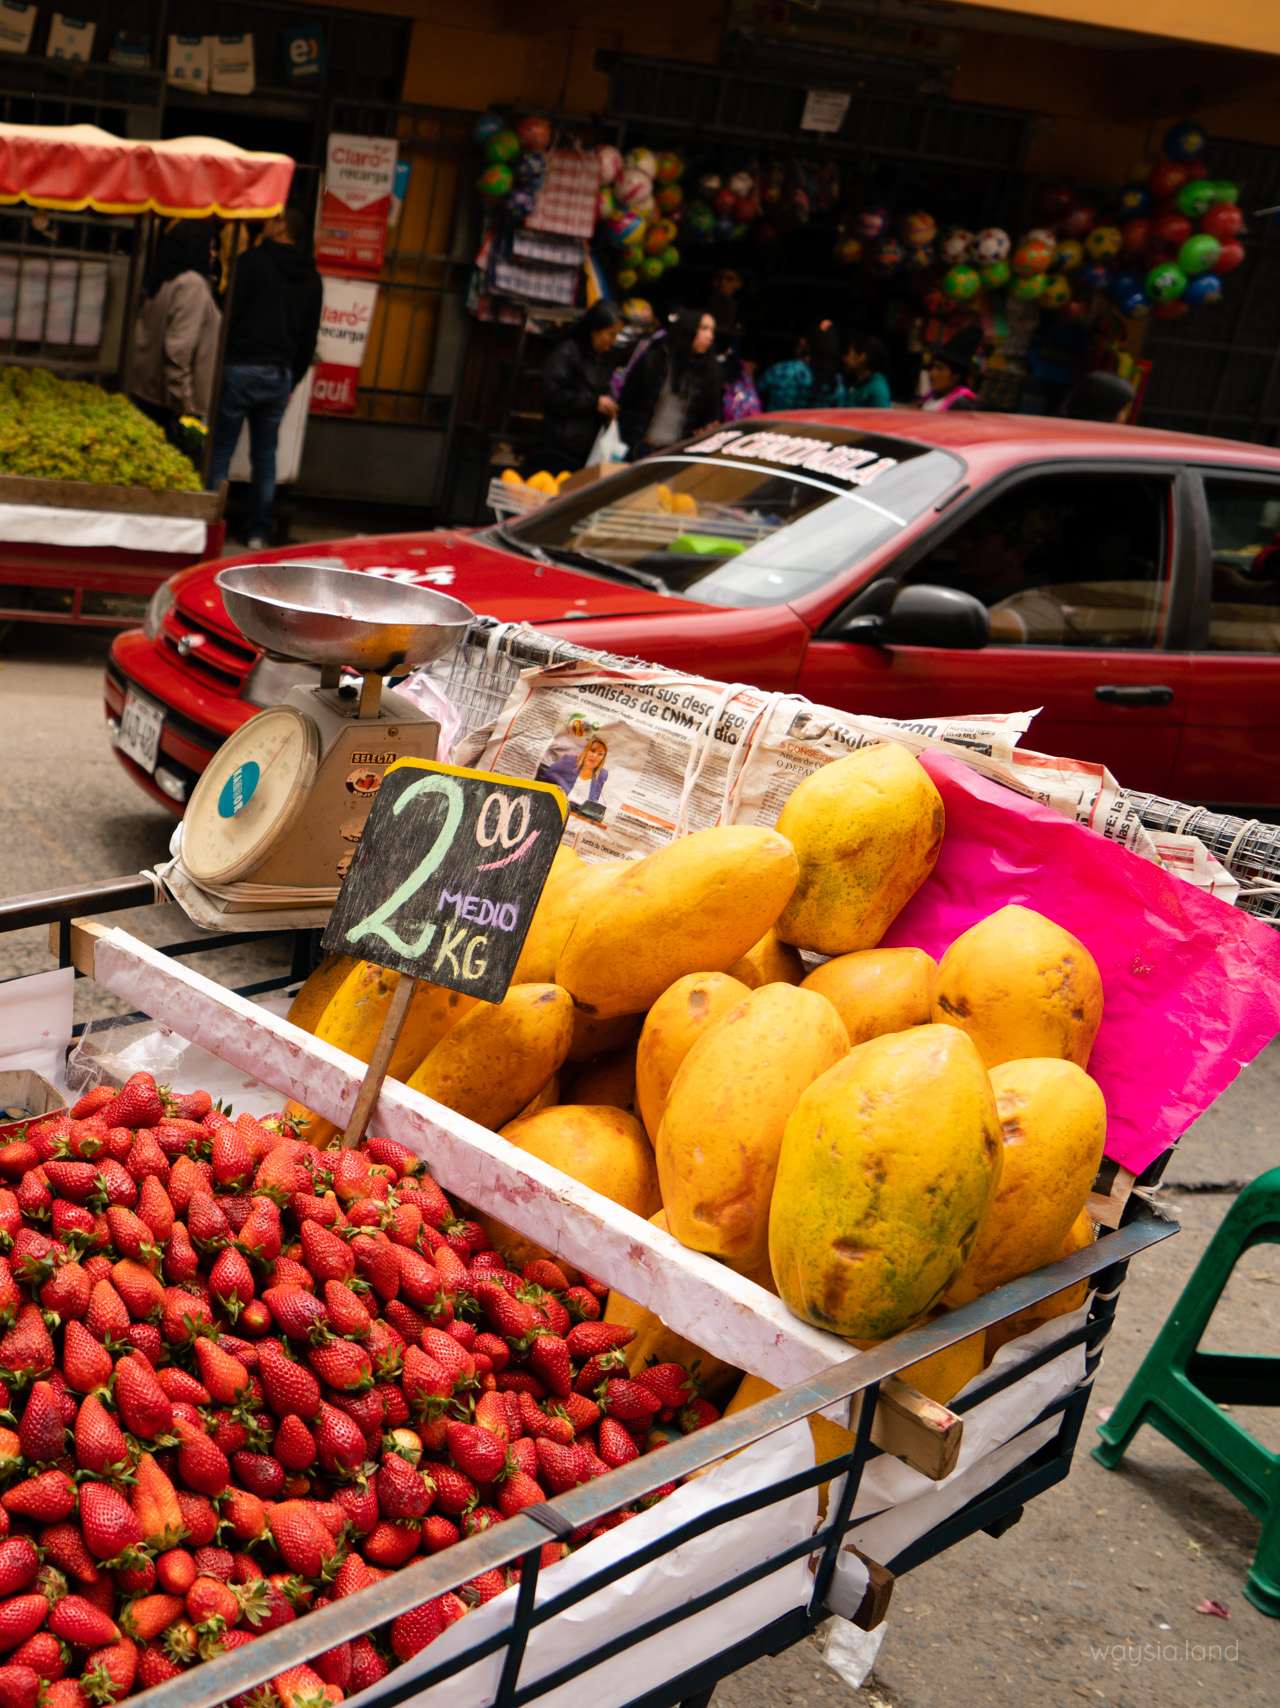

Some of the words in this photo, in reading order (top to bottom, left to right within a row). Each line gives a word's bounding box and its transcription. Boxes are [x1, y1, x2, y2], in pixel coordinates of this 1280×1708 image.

[331, 147, 380, 168] Claro
[340, 168, 389, 185] recarga
[322, 305, 358, 326] laro
[656, 687, 680, 705] sus
[639, 699, 659, 717] de
[660, 706, 694, 730] CNM
[962, 732, 977, 740] MLS
[353, 753, 395, 764] SELECTA
[779, 751, 803, 764] Antes
[1037, 792, 1051, 802] 21
[438, 888, 519, 932] MEDIO
[432, 925, 490, 980] KG
